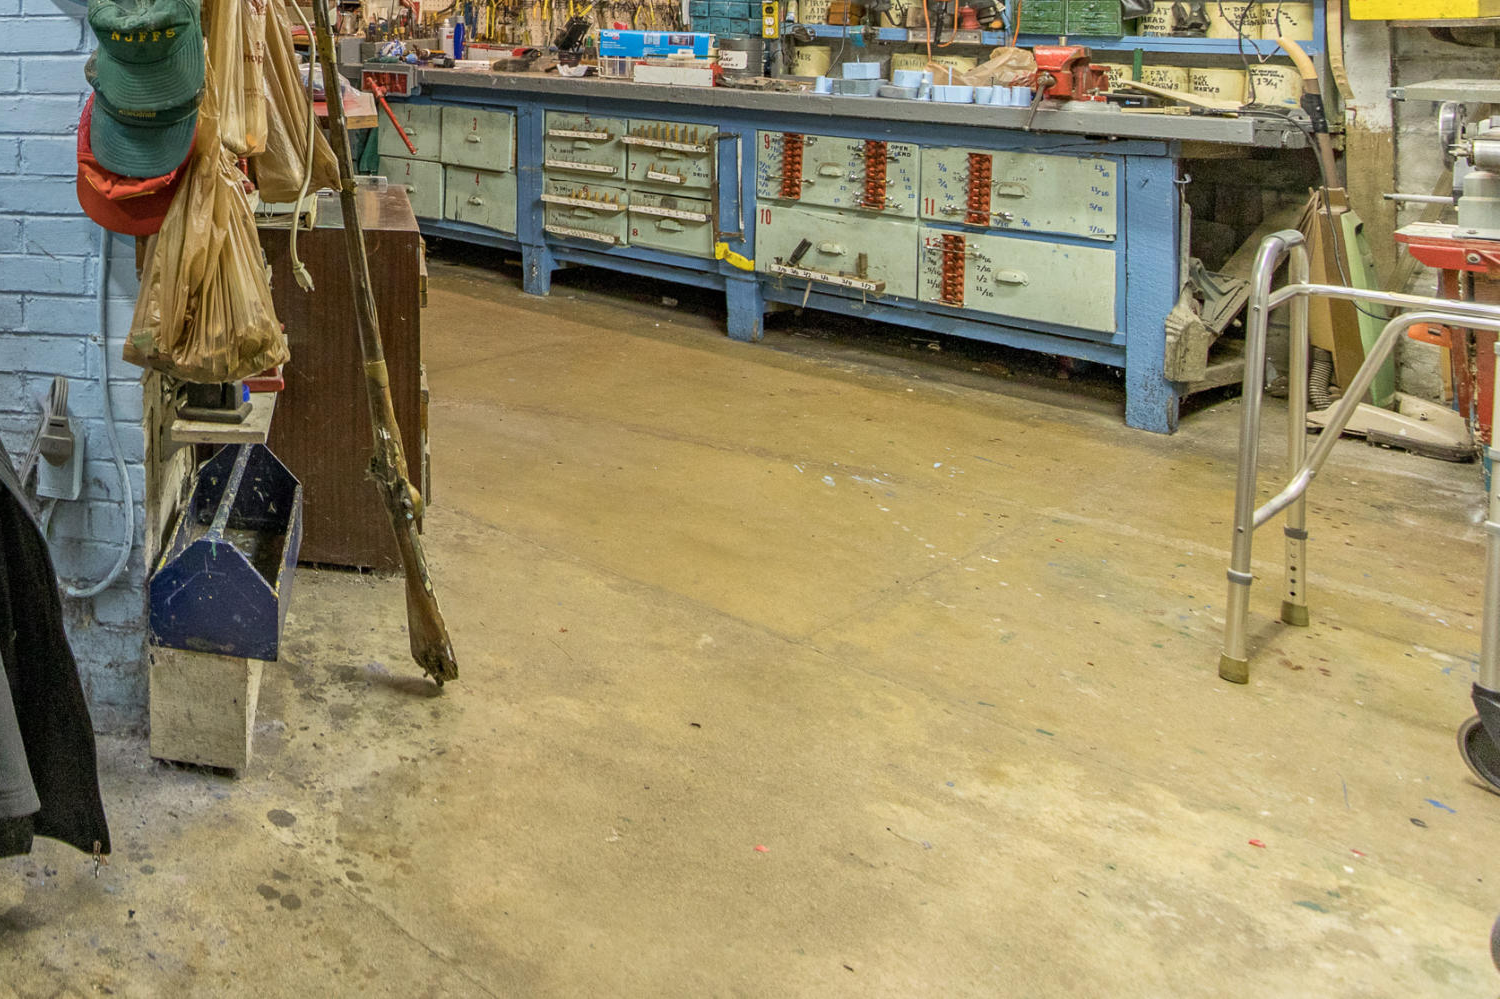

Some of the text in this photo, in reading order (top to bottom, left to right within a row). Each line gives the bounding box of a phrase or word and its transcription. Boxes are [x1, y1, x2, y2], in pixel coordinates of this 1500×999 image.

[1141, 16, 1165, 24] HEAD
[111, 28, 176, 43] NJFFS
[472, 117, 477, 131] 3
[584, 115, 590, 125] 5
[764, 133, 770, 149] 9
[405, 162, 411, 176] 2
[631, 162, 637, 171] 7
[582, 184, 589, 193] 6
[924, 197, 935, 216] 11
[760, 209, 772, 225] 10
[632, 228, 639, 237] 8
[975, 274, 988, 283] 1/2
[975, 286, 994, 297] 11/16
